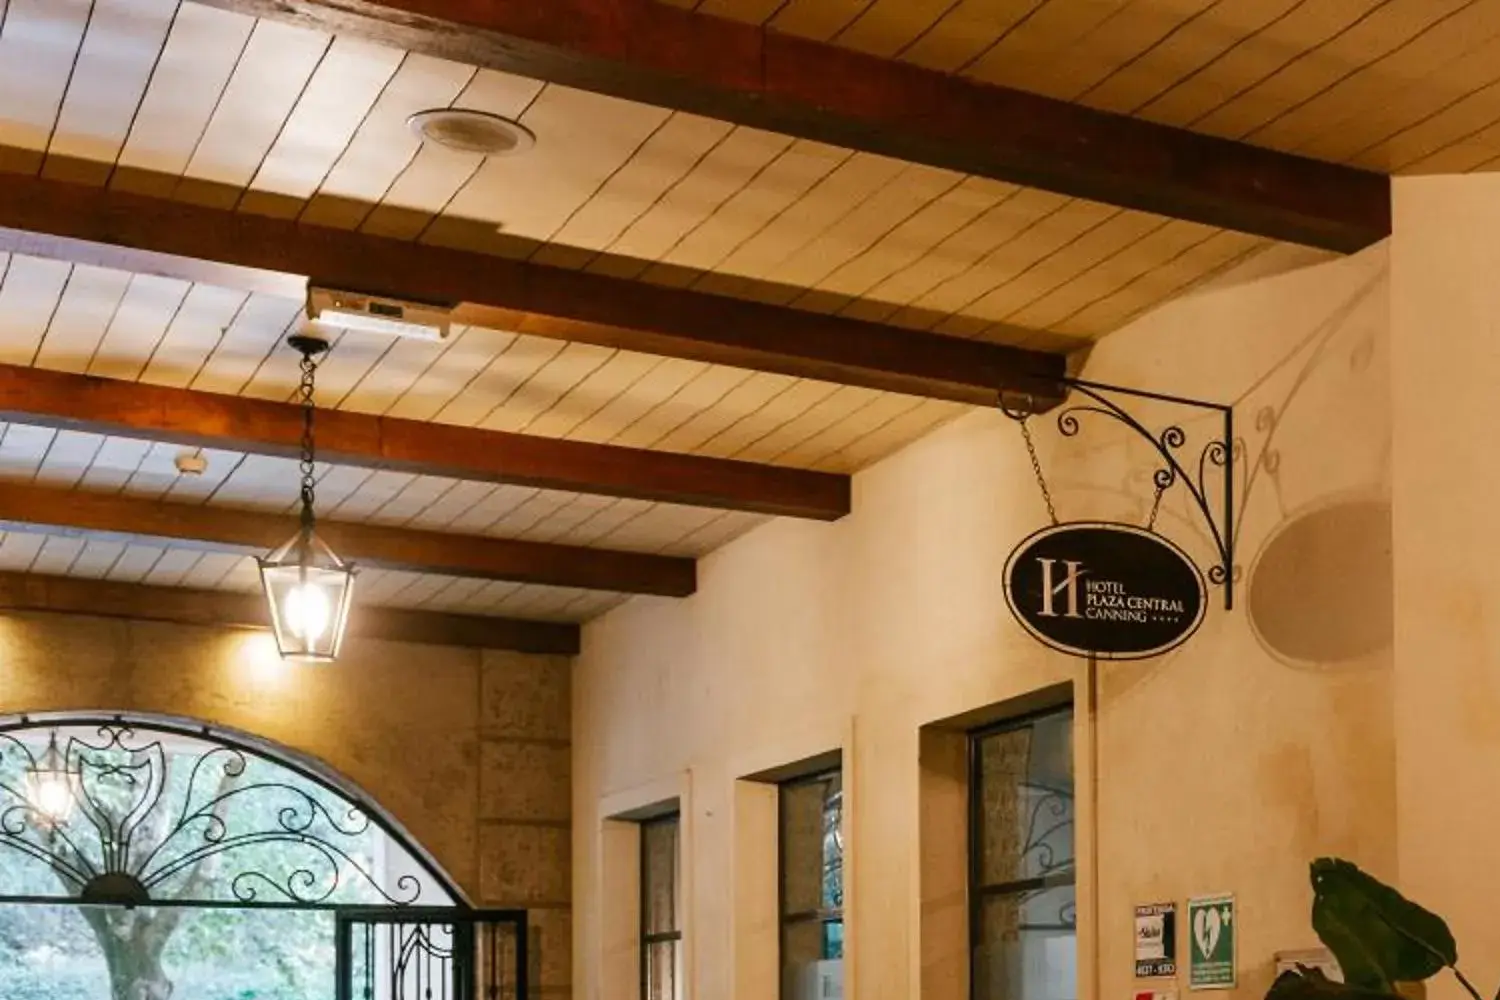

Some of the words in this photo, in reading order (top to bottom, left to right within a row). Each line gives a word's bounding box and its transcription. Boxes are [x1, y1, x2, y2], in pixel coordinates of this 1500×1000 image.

[1086, 579, 1126, 595] HOTEL
[1087, 594, 1125, 608] PLAZA
[1127, 597, 1185, 613] CENTRAL
[1085, 608, 1147, 623] CANNING
